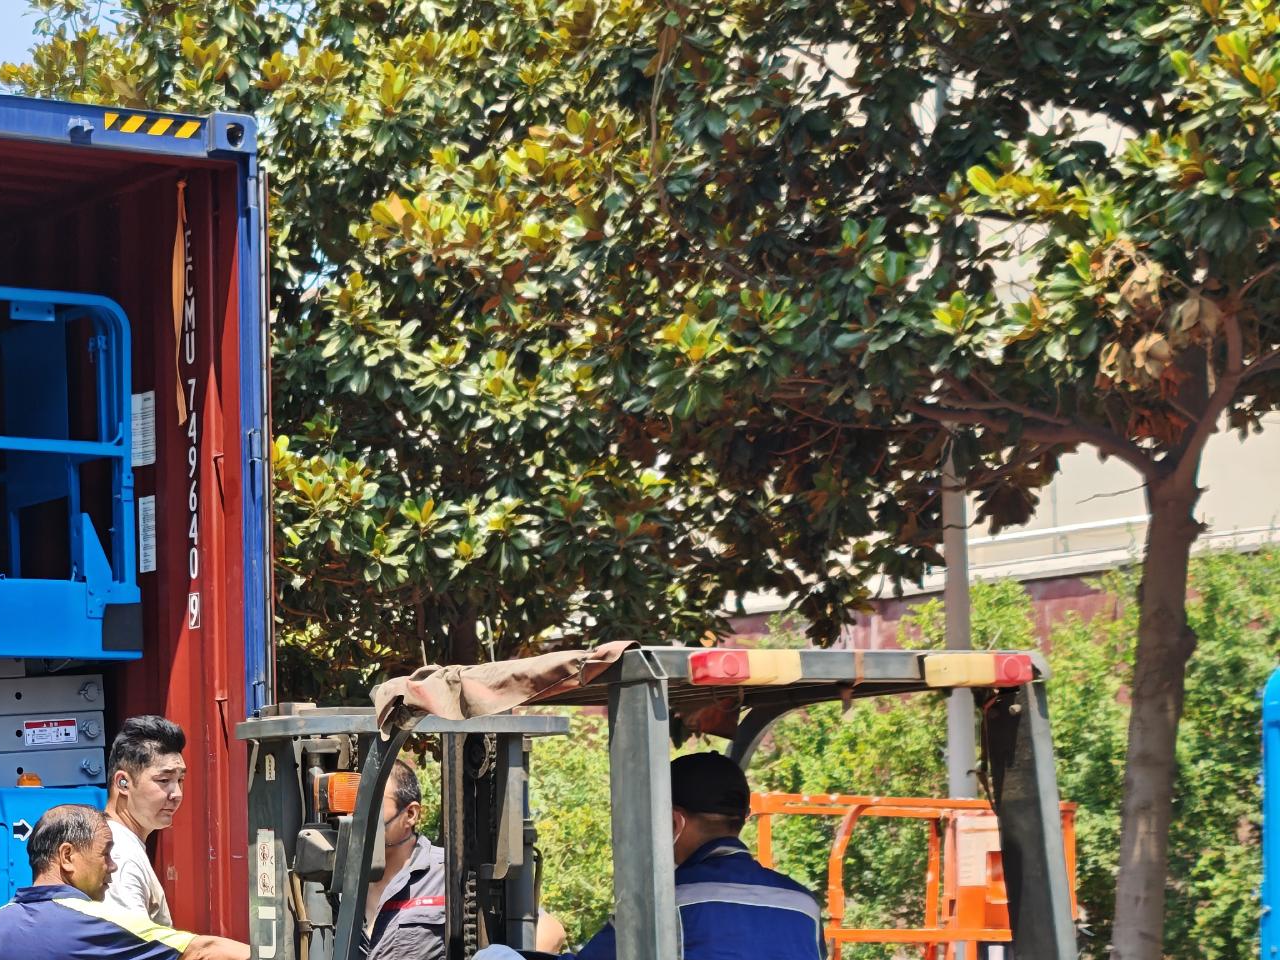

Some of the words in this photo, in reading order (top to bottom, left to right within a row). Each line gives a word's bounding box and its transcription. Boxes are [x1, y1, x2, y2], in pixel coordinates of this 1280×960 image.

[184, 230, 196, 365] ECMU
[187, 378, 199, 580] 749640
[189, 593, 200, 629] 9
